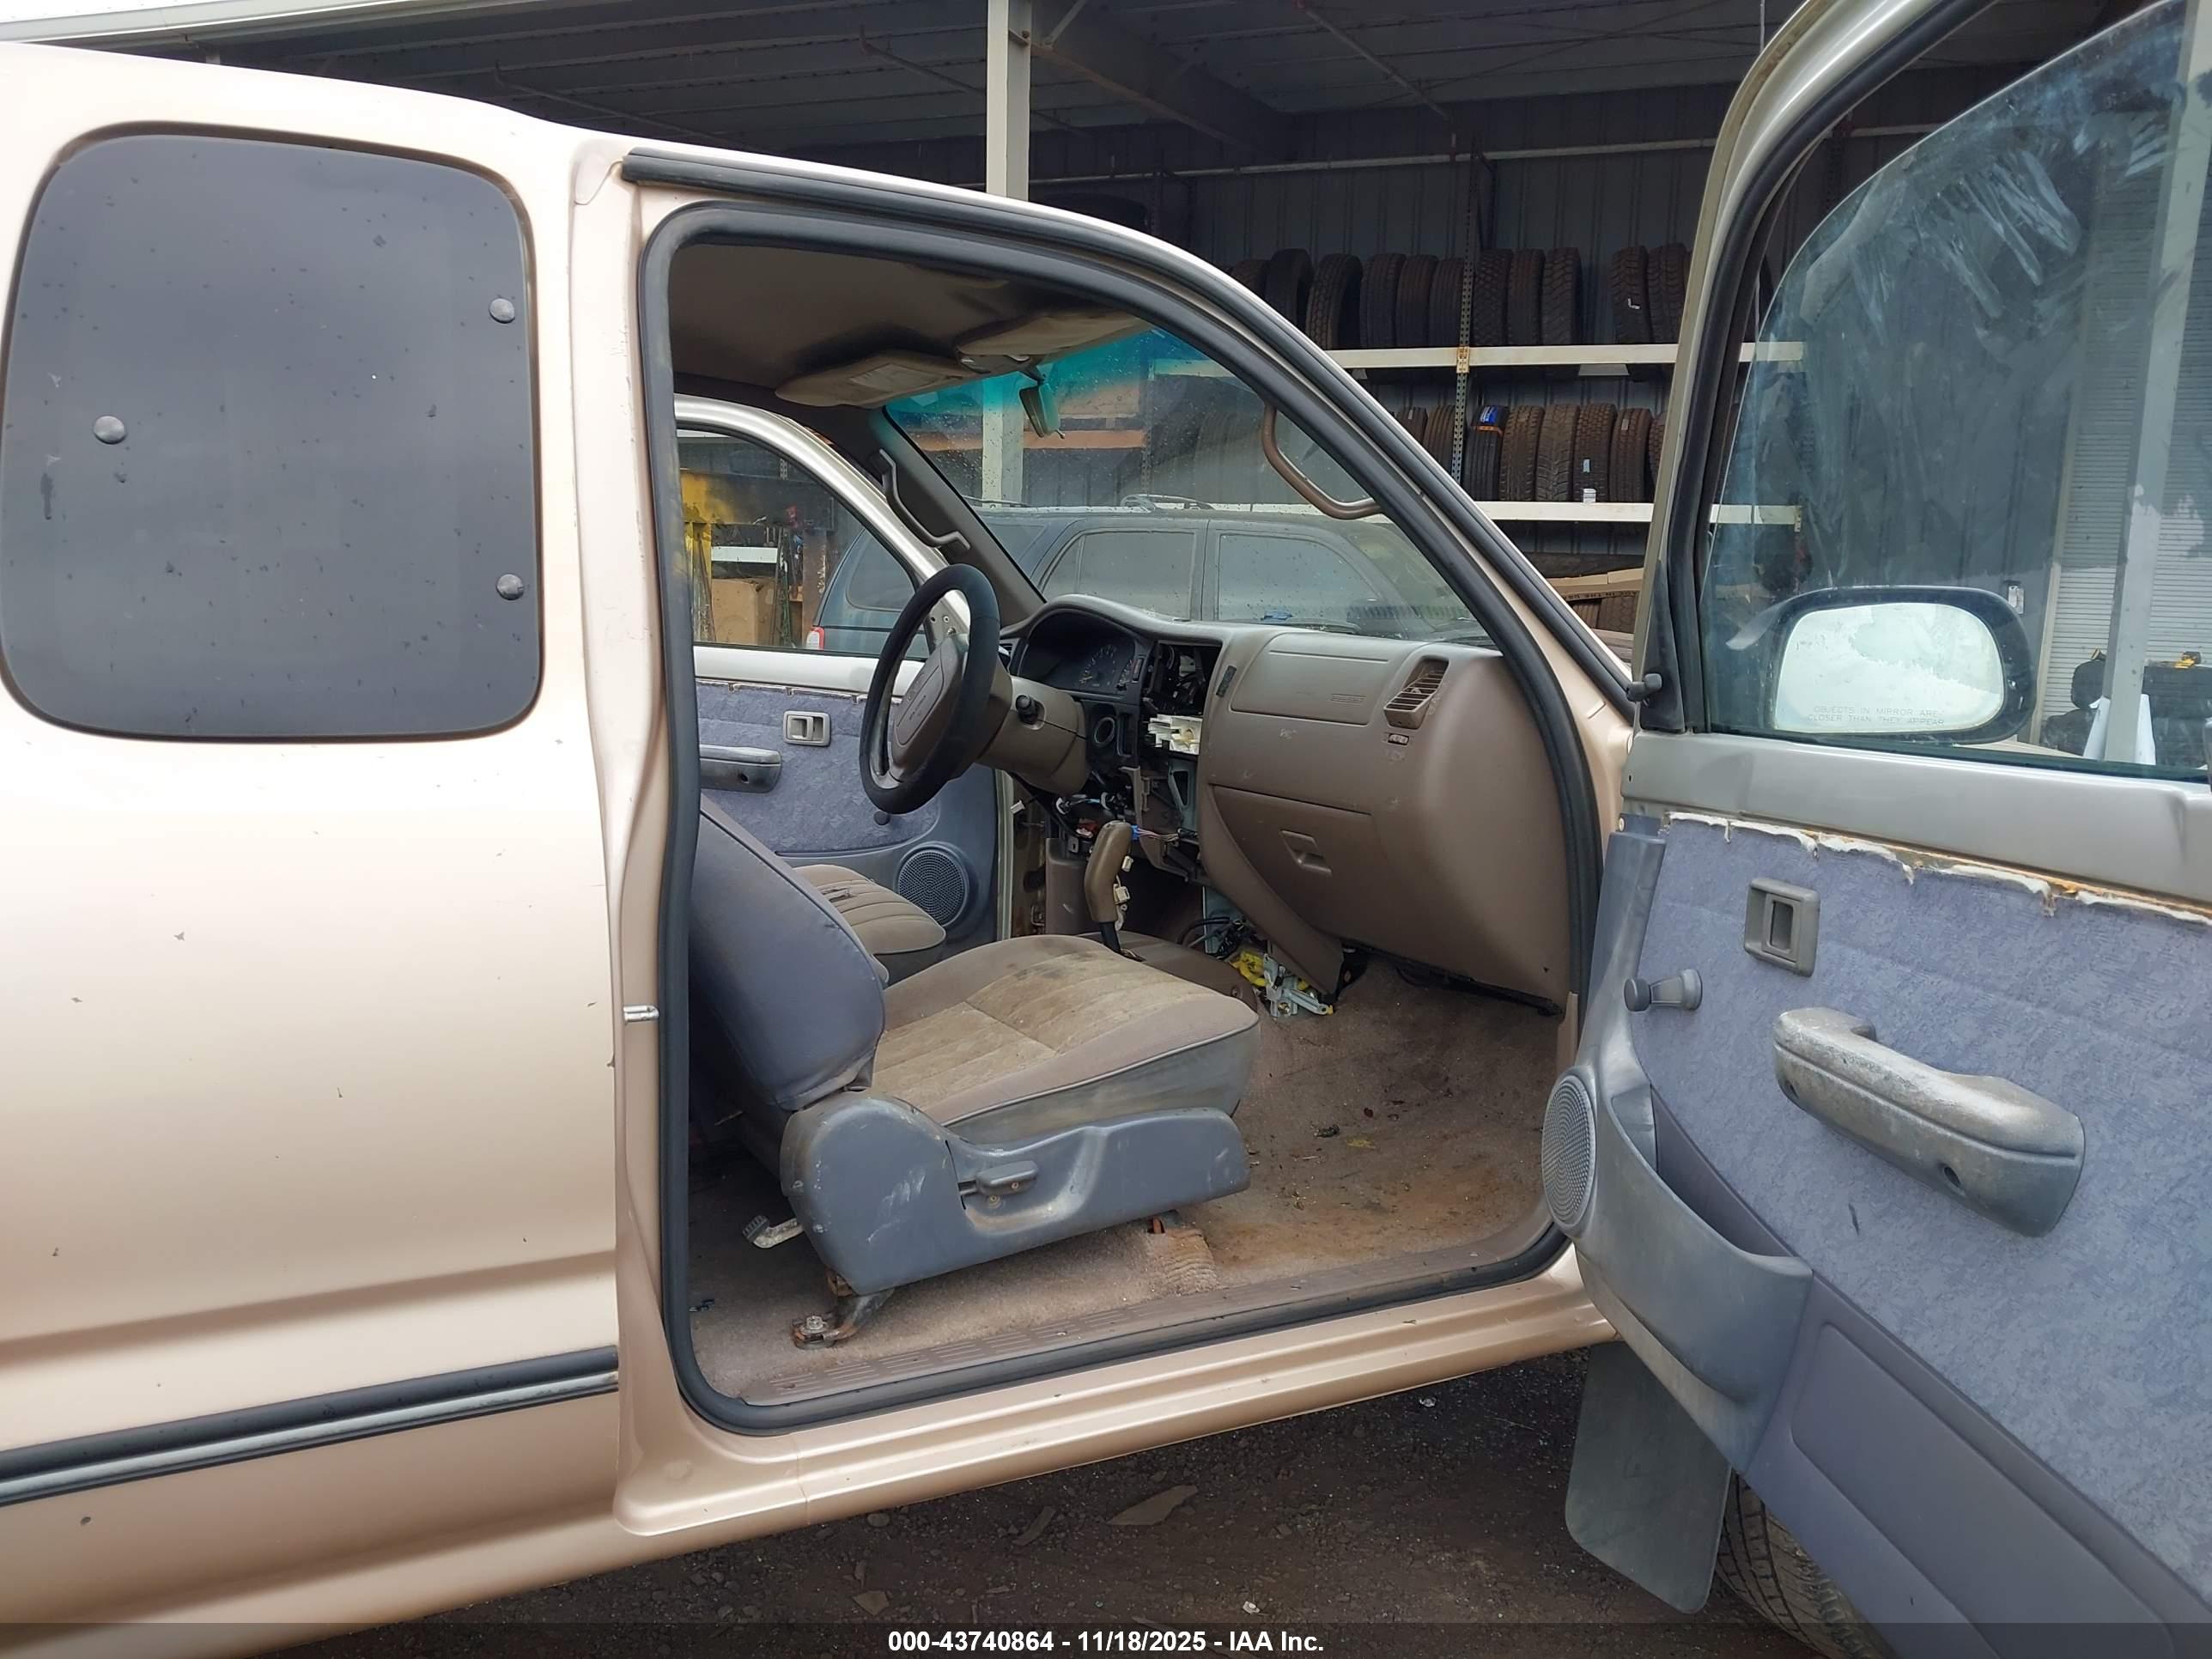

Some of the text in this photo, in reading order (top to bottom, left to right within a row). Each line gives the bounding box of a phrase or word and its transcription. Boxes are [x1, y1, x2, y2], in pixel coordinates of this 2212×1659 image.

[1813, 706, 1856, 714] OBJECTS
[1875, 708, 1913, 716] MIRROR
[1919, 709, 1939, 718] ARE
[1879, 716, 1901, 725] THEY
[1908, 717, 1945, 726] APPEAR
